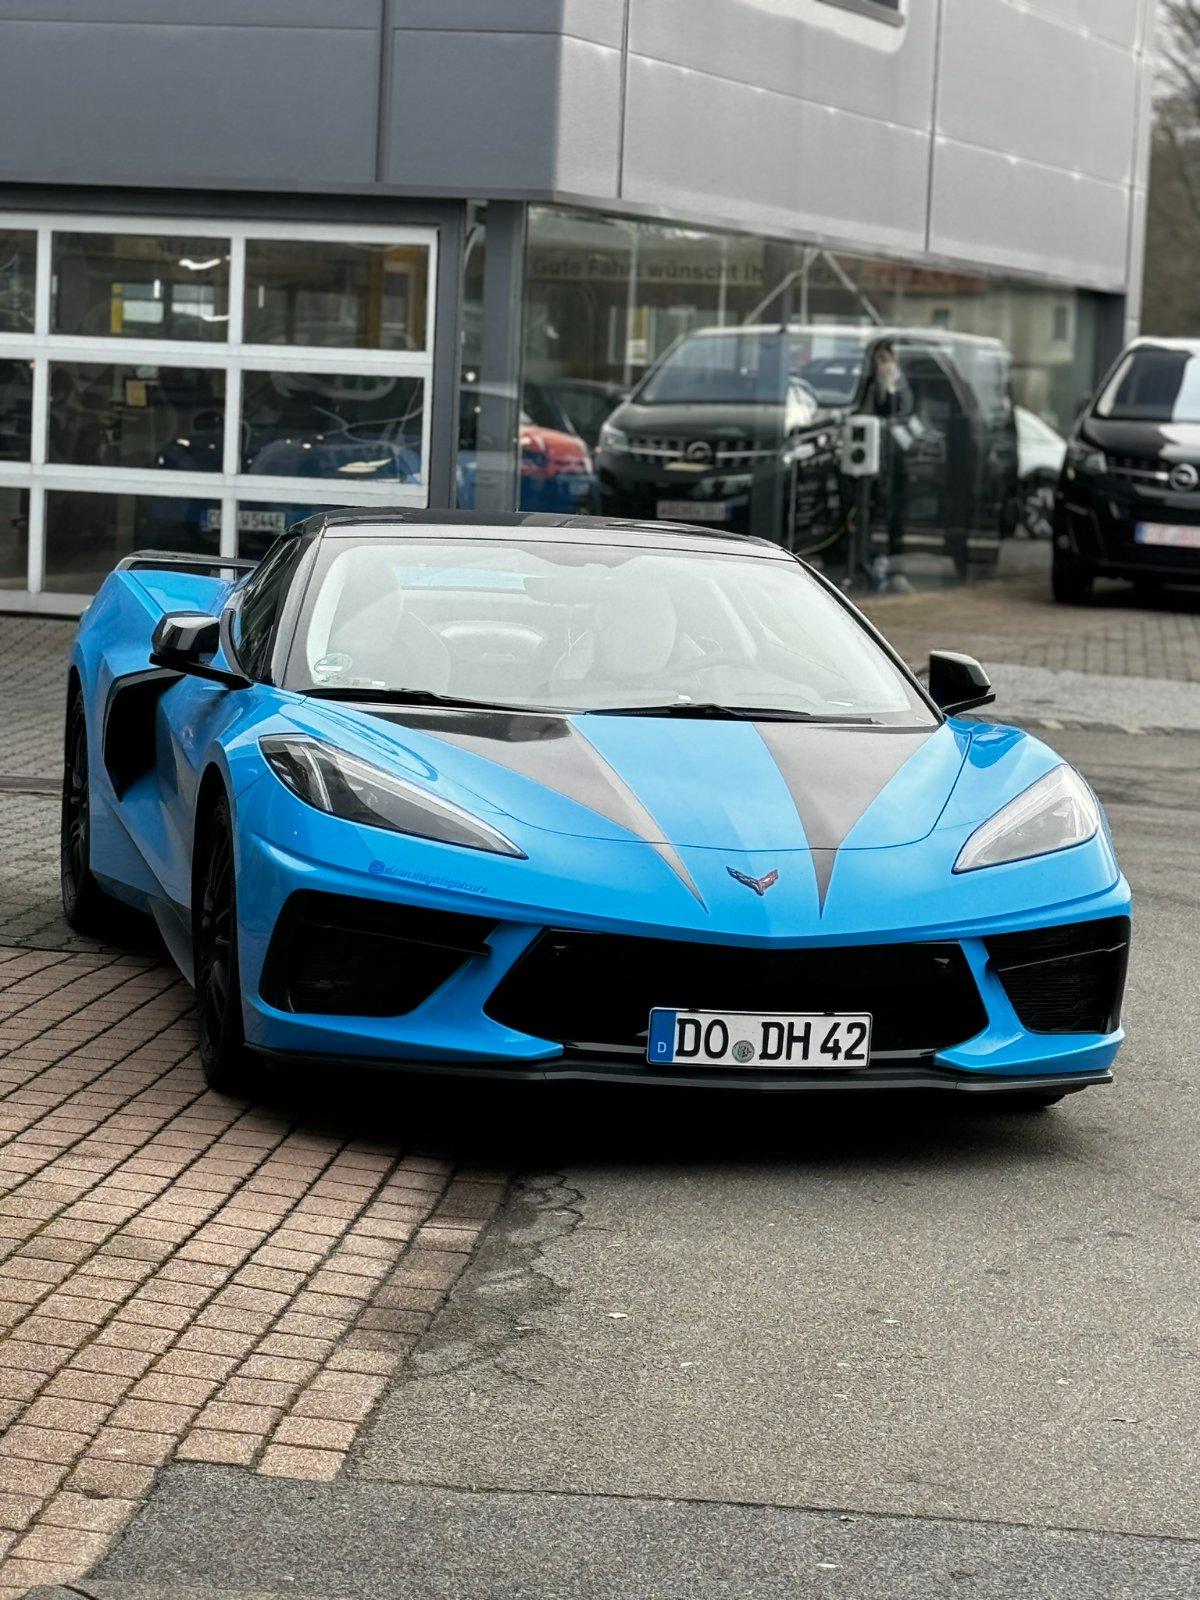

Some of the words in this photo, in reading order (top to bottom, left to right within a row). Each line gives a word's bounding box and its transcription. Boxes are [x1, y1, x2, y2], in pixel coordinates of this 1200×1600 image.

[532, 257, 581, 276] Gute
[744, 263, 764, 282] Ih
[657, 1042, 667, 1053] D
[675, 1018, 729, 1059] DO
[759, 1021, 812, 1061] DH
[819, 1022, 867, 1061] 42
